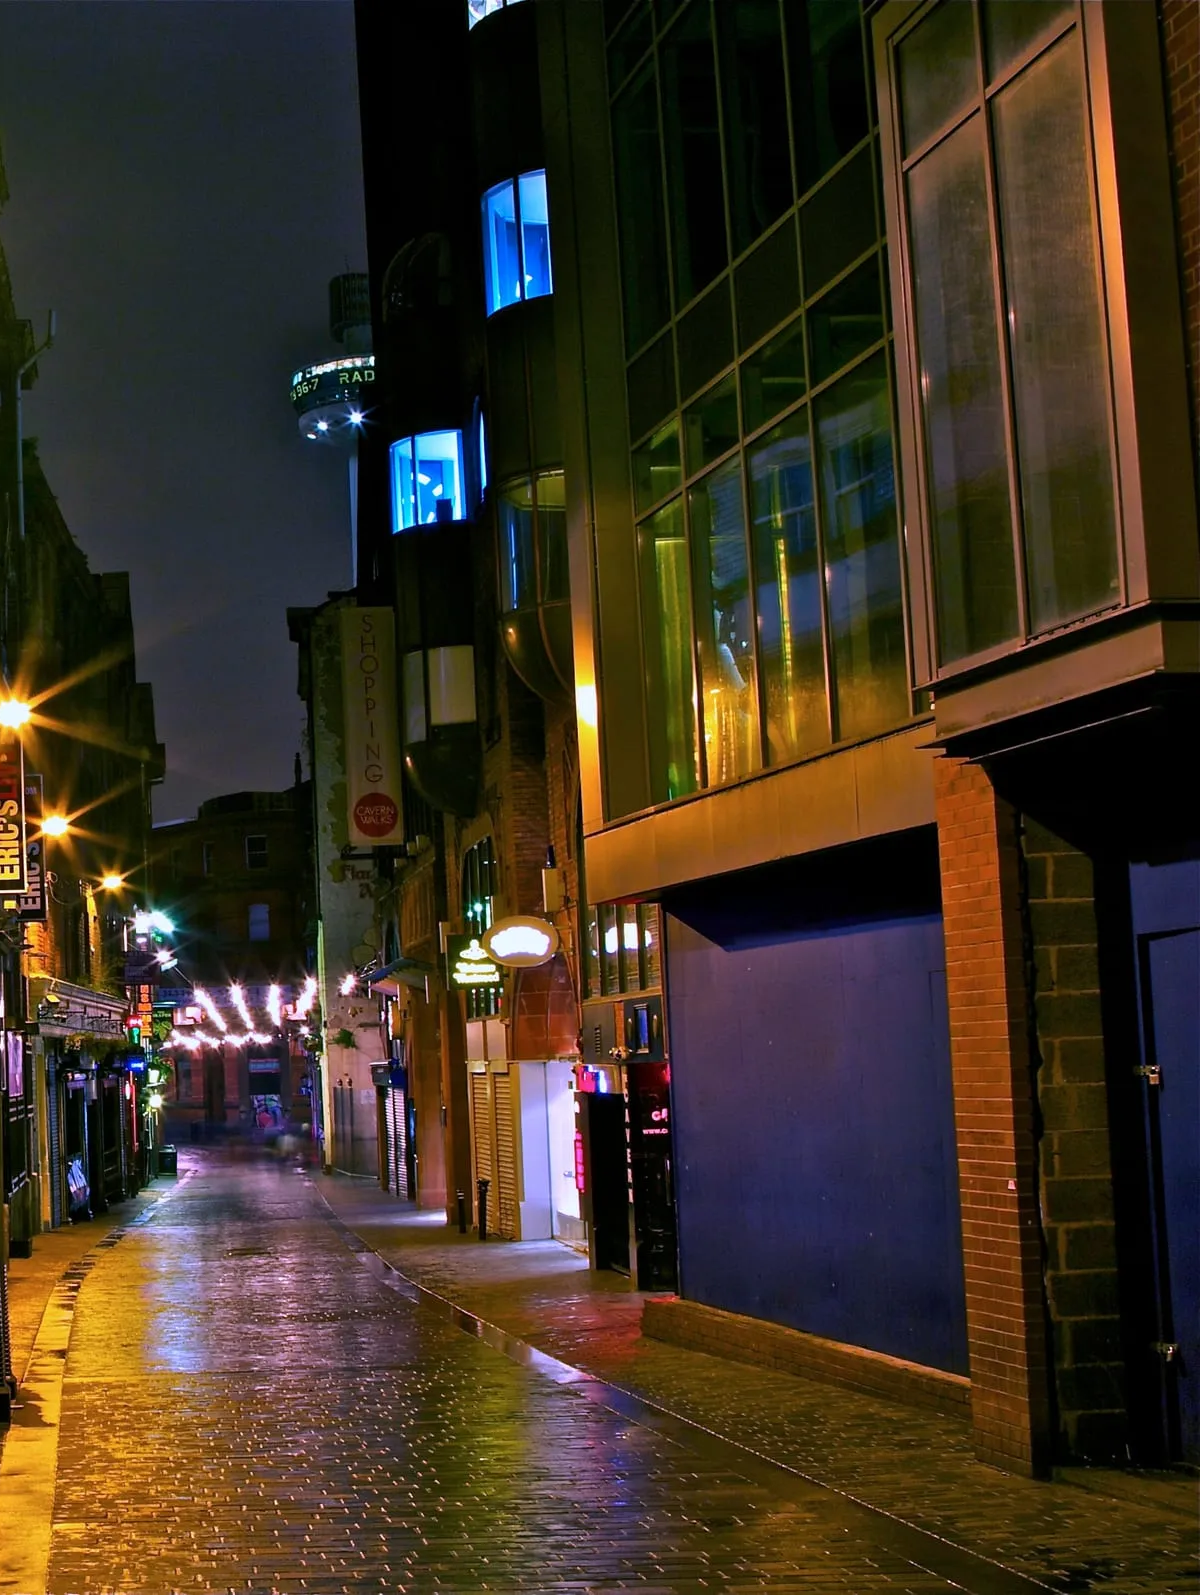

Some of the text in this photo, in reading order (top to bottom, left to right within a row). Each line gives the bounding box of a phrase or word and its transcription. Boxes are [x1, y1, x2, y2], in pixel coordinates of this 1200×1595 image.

[360, 614, 384, 784] SHOPPING
[356, 806, 394, 816] CAVERN
[360, 815, 394, 824] WALKS
